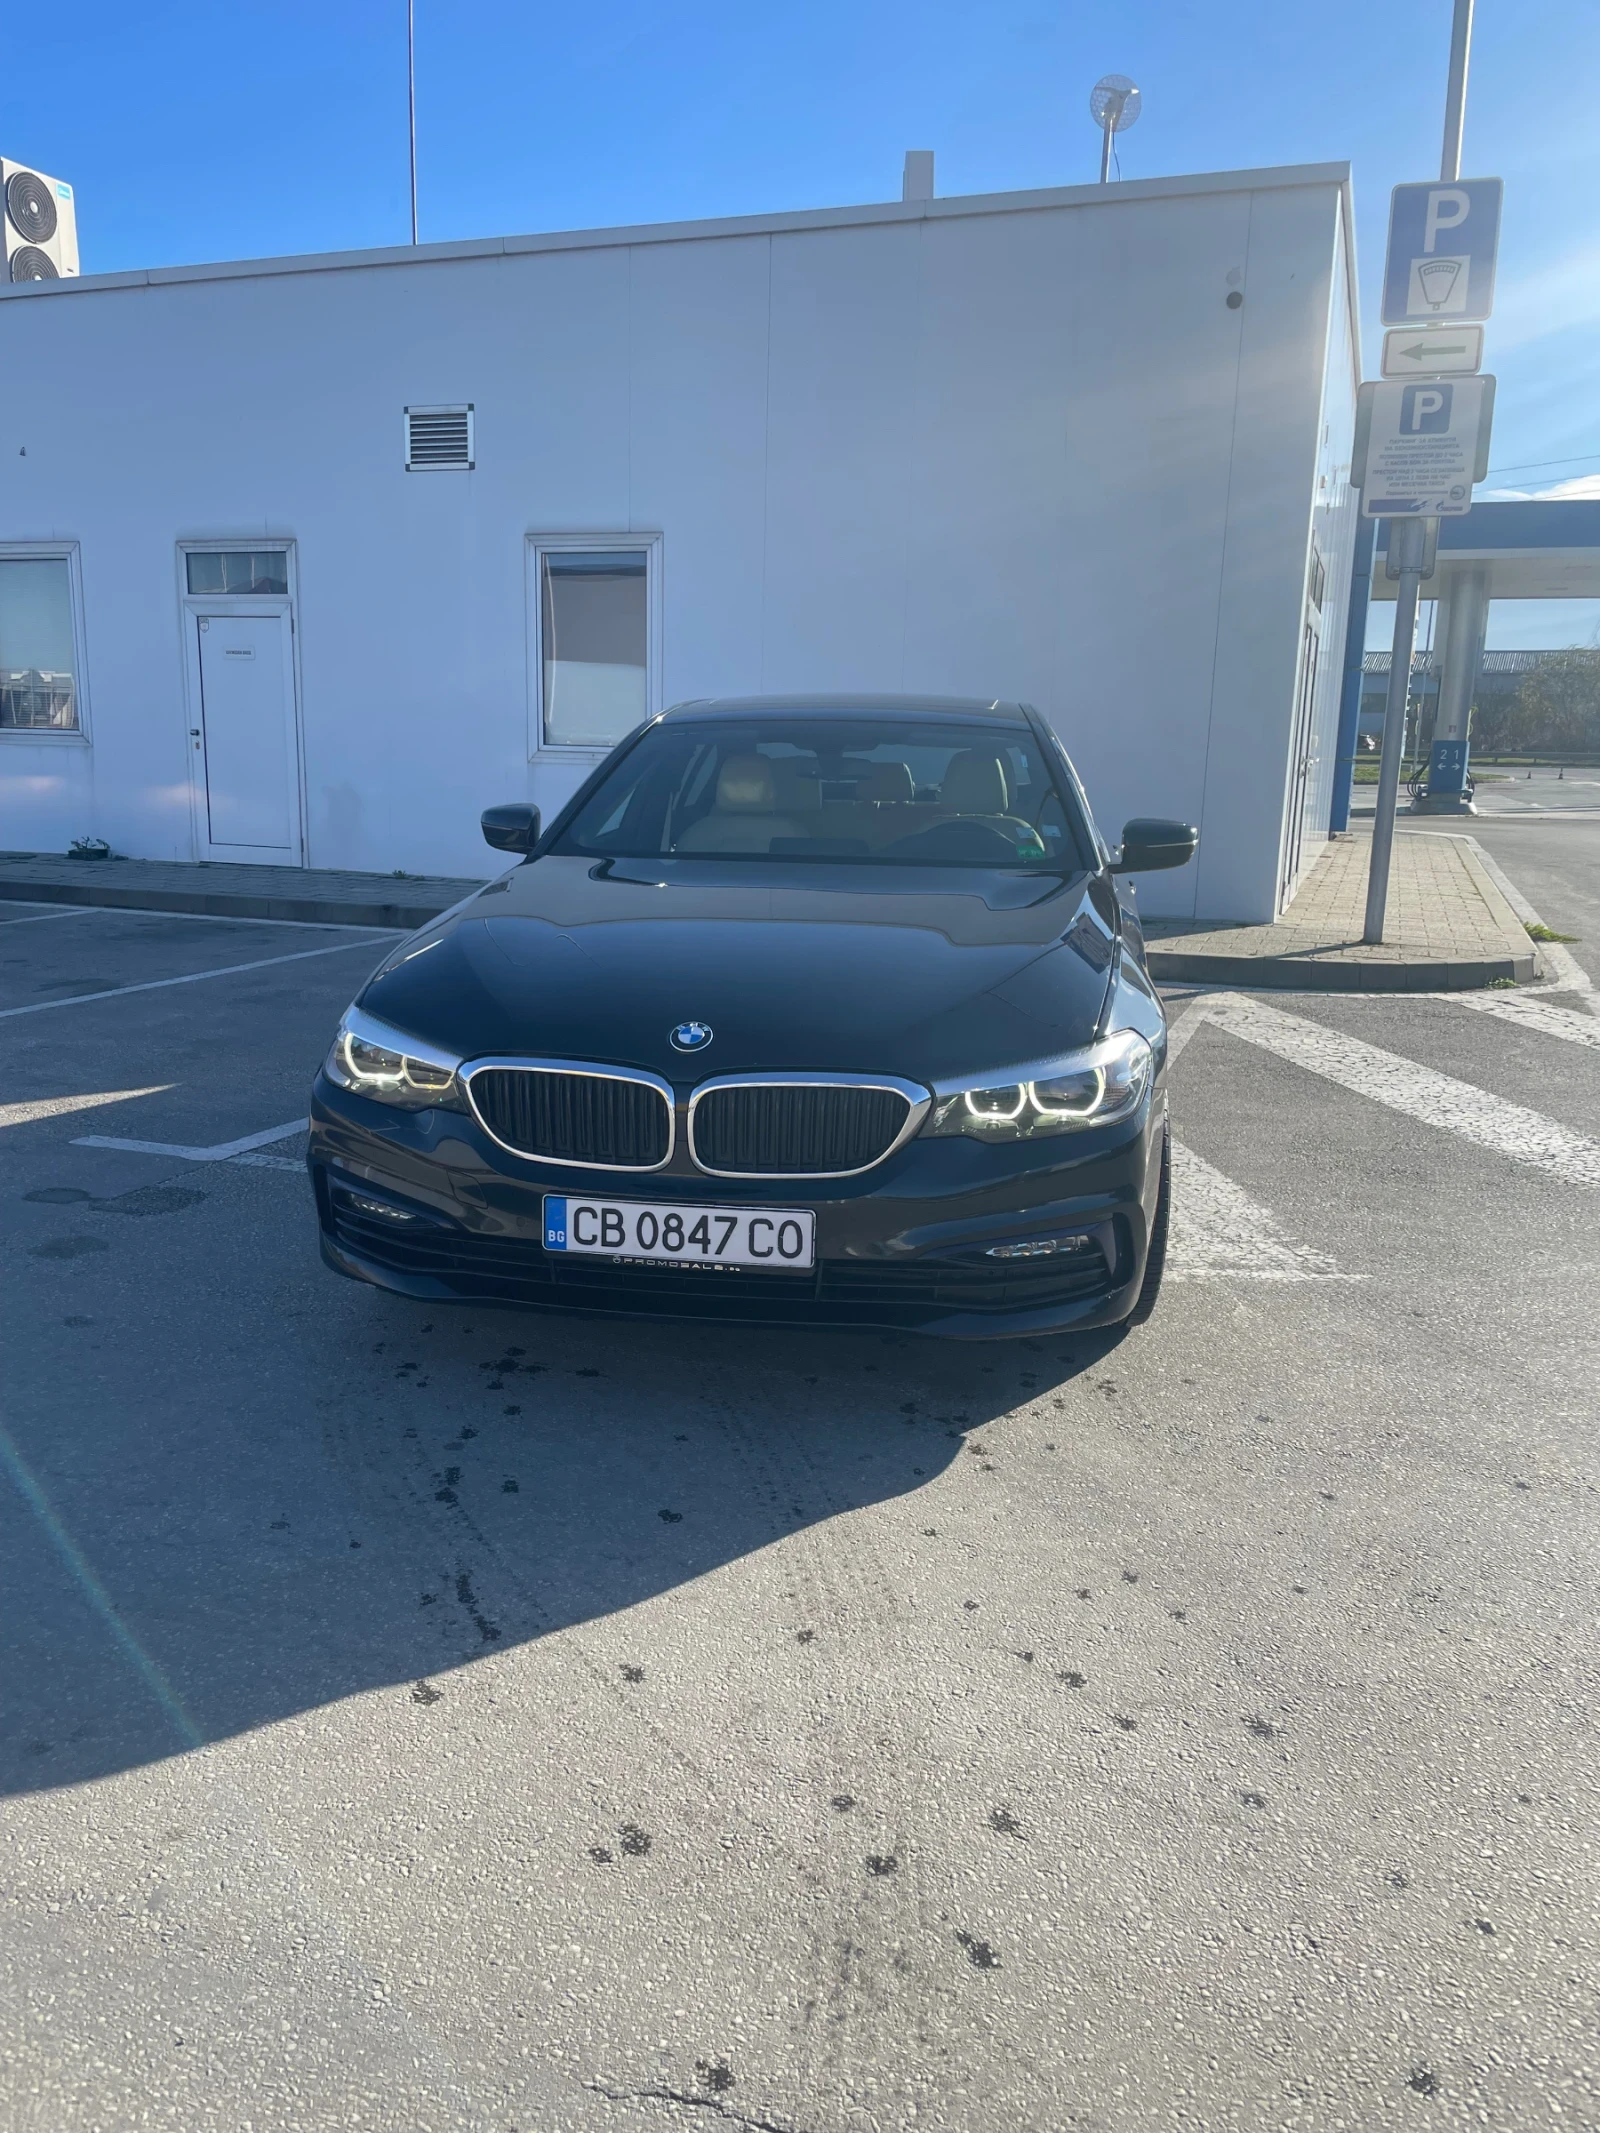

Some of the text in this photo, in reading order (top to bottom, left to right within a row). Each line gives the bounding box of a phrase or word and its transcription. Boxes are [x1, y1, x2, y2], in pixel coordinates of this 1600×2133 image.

[1424, 189, 1471, 253] P
[1412, 391, 1443, 430] P
[1440, 749, 1459, 760] 2 1
[548, 1230, 565, 1242] BG
[573, 1206, 626, 1248] CB
[636, 1211, 738, 1255] 0847
